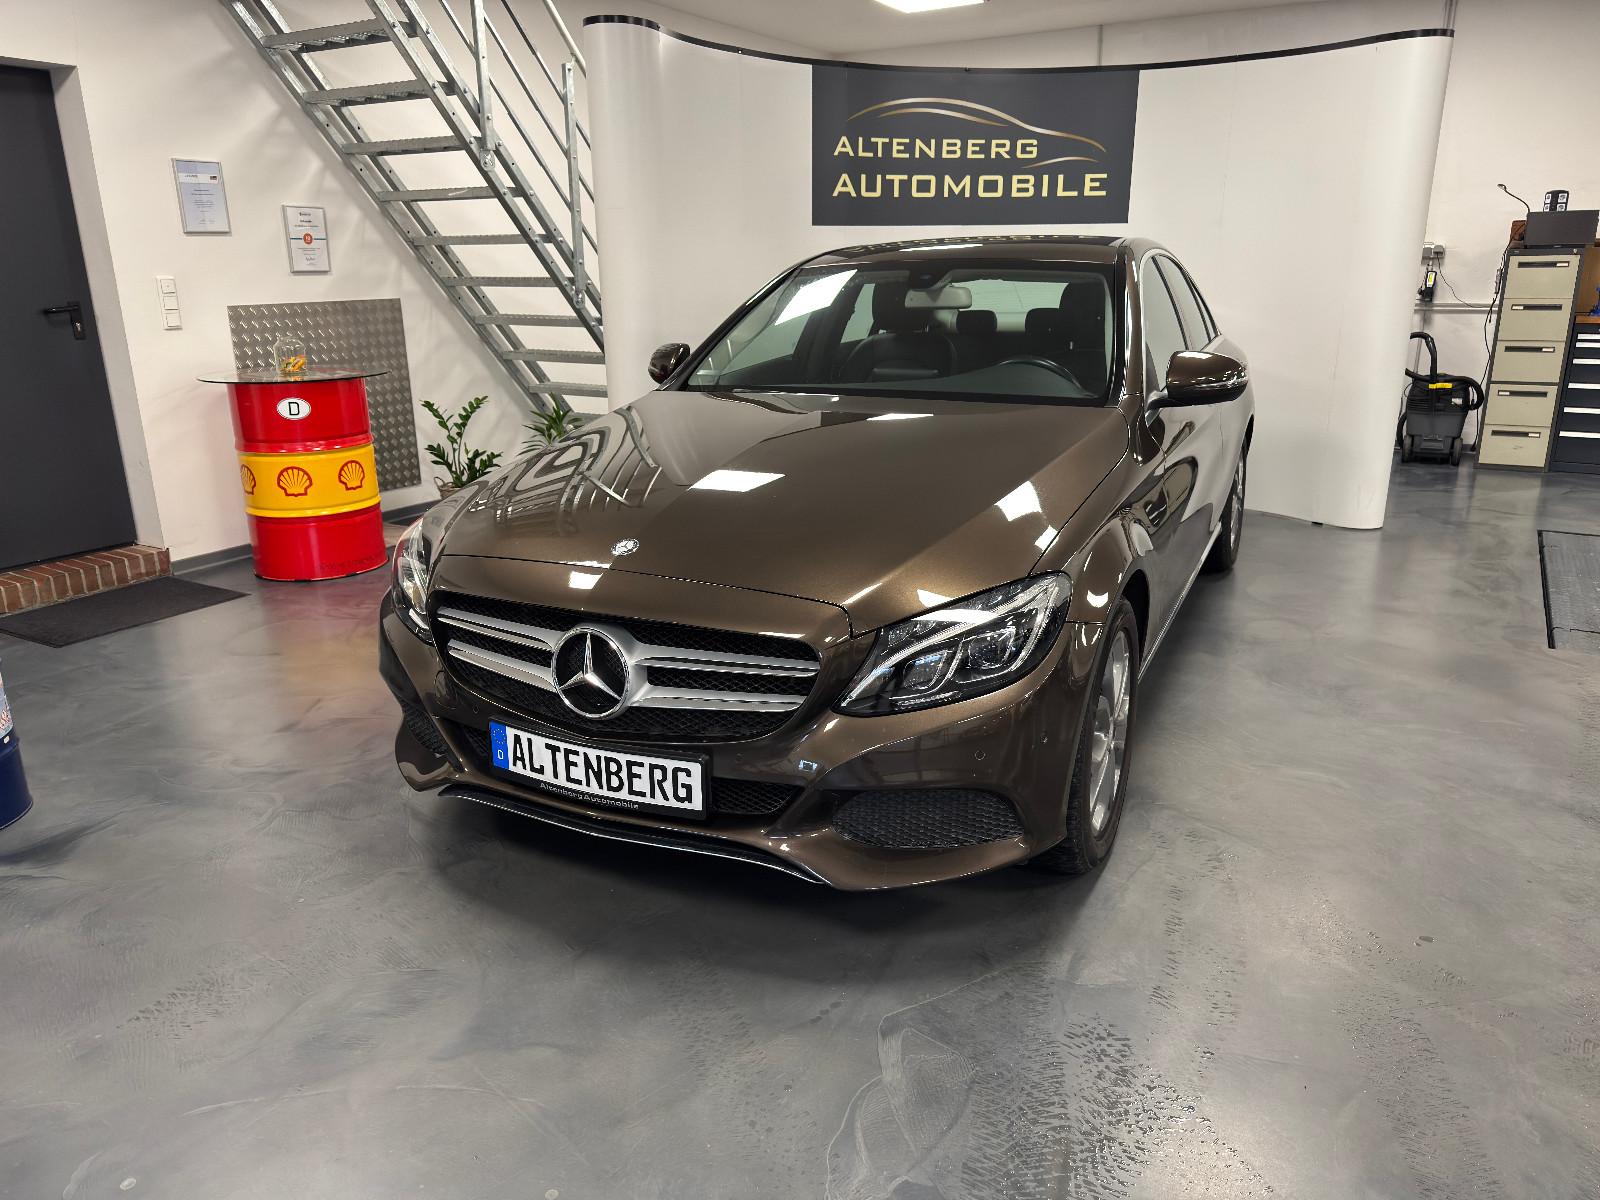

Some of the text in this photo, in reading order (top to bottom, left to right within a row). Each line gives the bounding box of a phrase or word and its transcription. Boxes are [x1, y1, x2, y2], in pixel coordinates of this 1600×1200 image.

[833, 135, 1038, 160] ALTENBERG
[832, 173, 1108, 198] AUTOMOBILE
[288, 401, 300, 416] D
[497, 749, 504, 760] D
[512, 733, 693, 804] ALTENBERG
[539, 782, 640, 810] Altenberg Automobile
